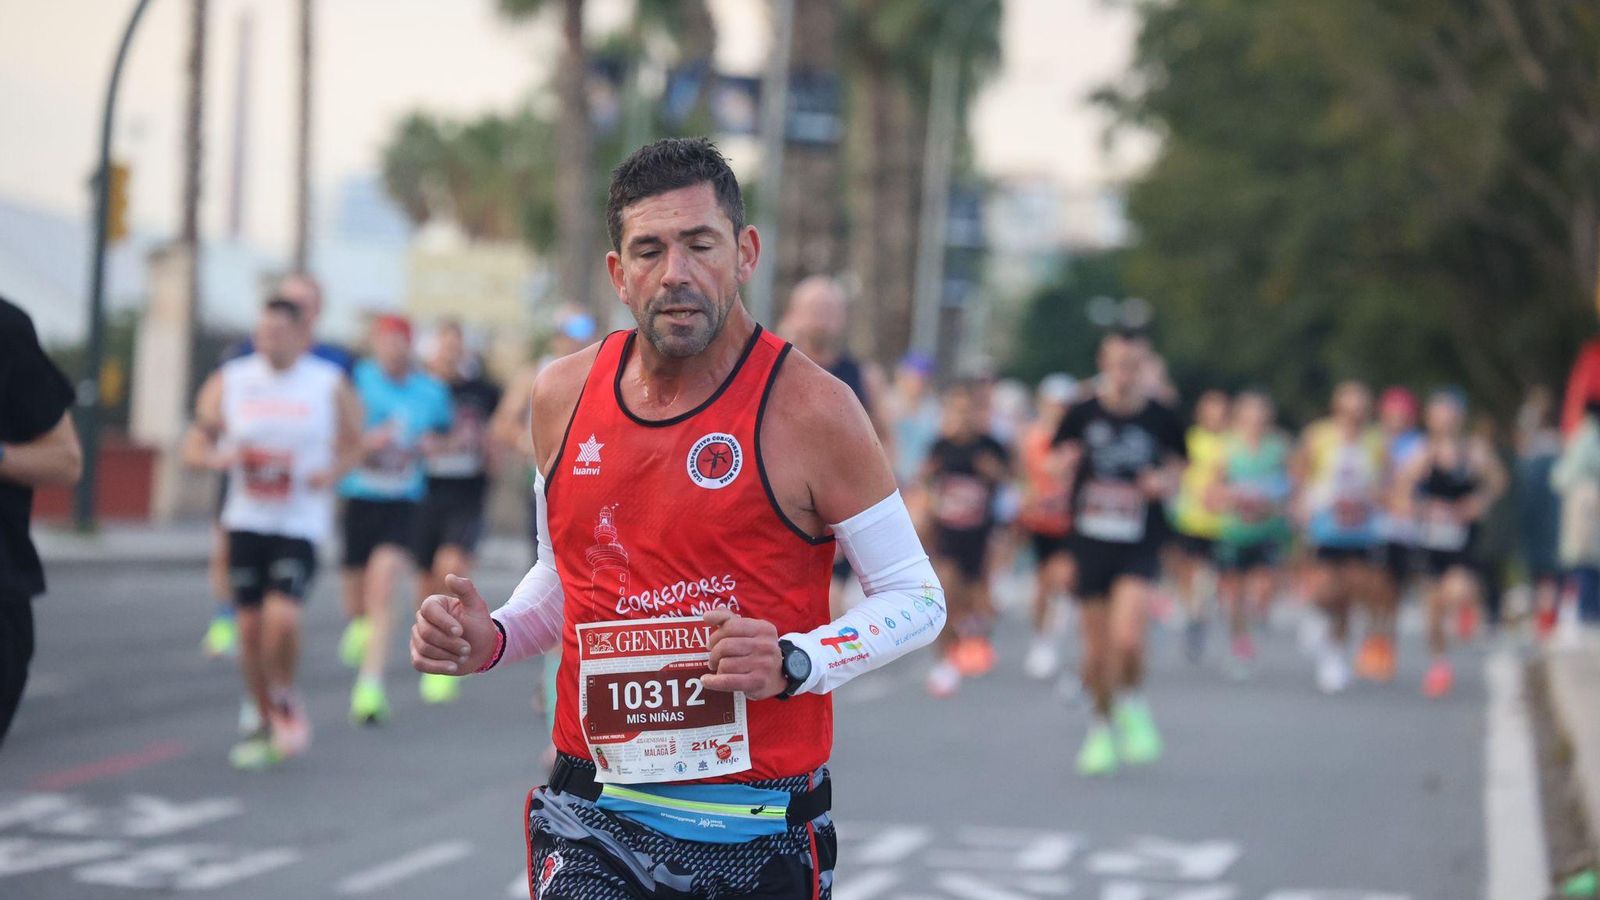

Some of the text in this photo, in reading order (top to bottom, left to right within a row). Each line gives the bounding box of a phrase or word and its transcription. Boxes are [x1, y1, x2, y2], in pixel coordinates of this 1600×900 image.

[572, 465, 601, 476] luanvi
[615, 574, 736, 615] CORREDORES
[607, 677, 706, 711] 10312
[626, 710, 685, 724] MIS NIÑAS
[691, 738, 719, 752] 21K
